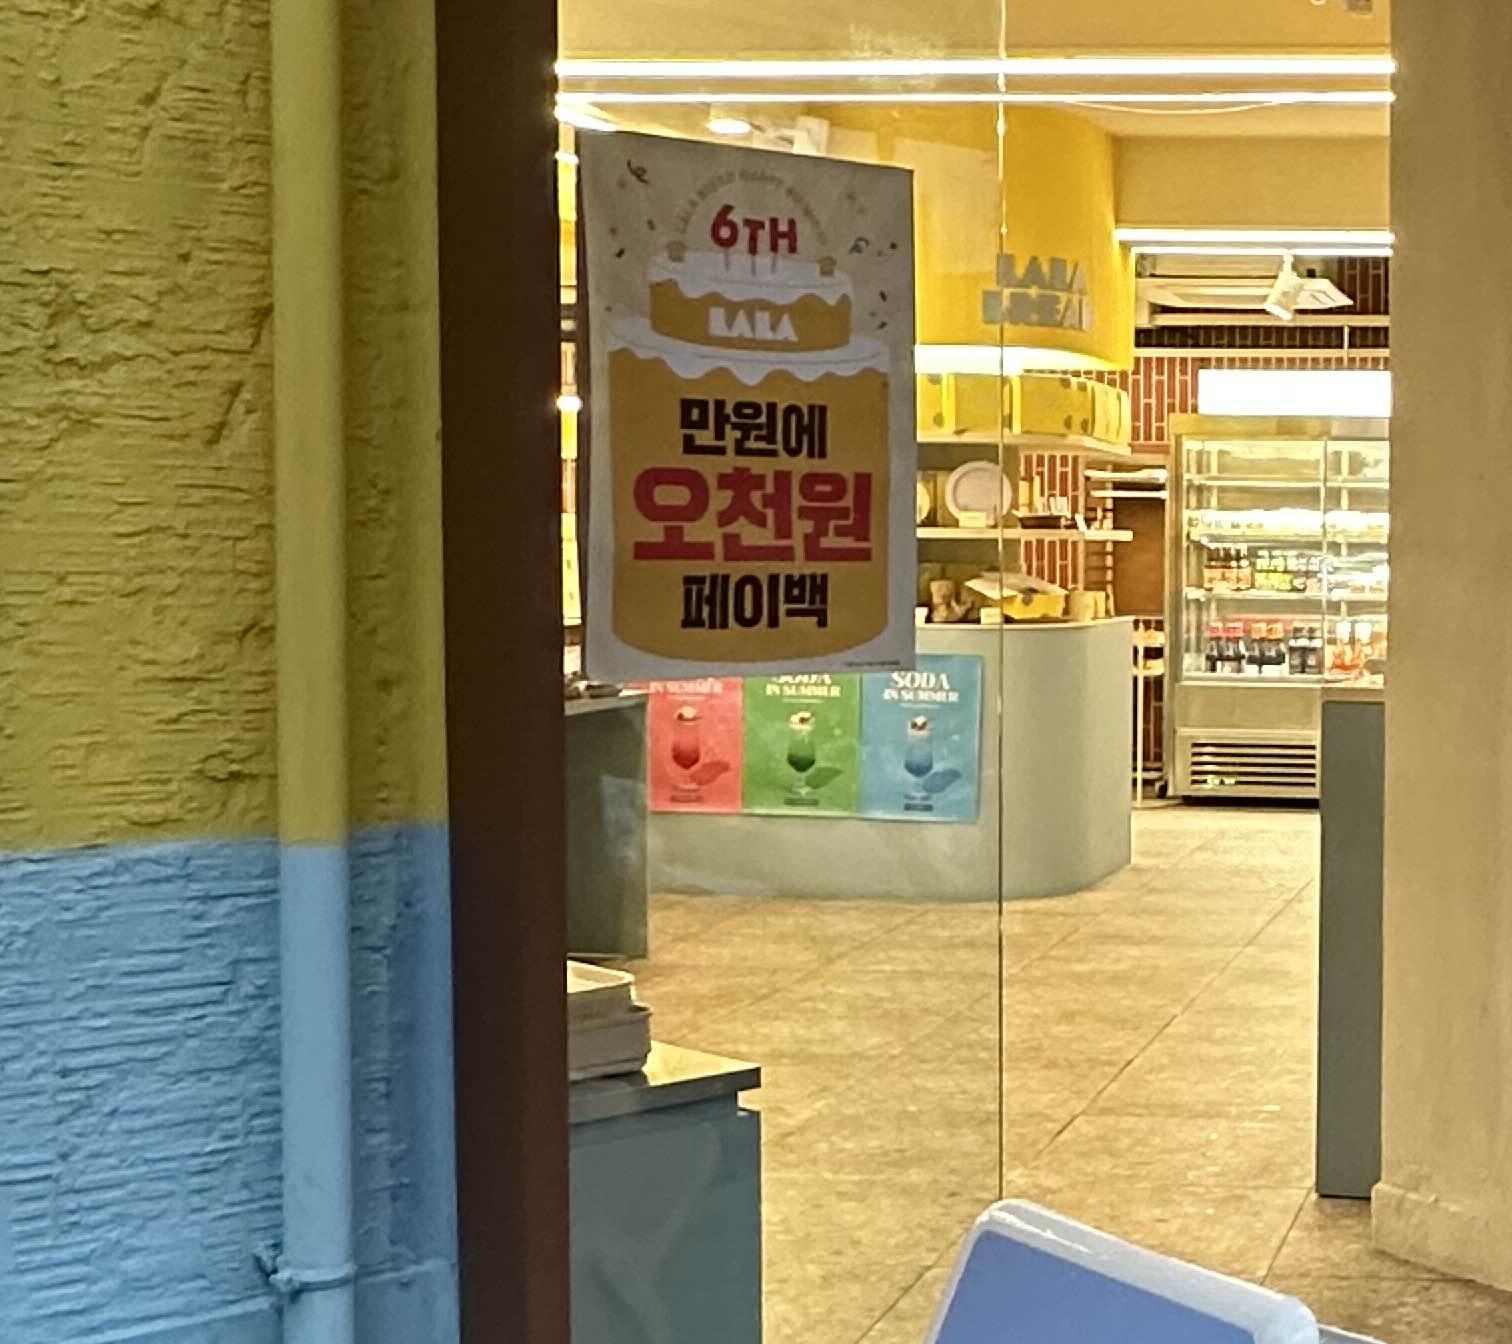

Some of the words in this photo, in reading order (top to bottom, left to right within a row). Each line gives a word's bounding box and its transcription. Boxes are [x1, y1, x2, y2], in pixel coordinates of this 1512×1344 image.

[710, 204, 799, 256] 6TH
[708, 307, 799, 342] LALA
[679, 397, 829, 460] 만원에
[632, 466, 873, 562] 오천원
[680, 572, 829, 630] 페이백
